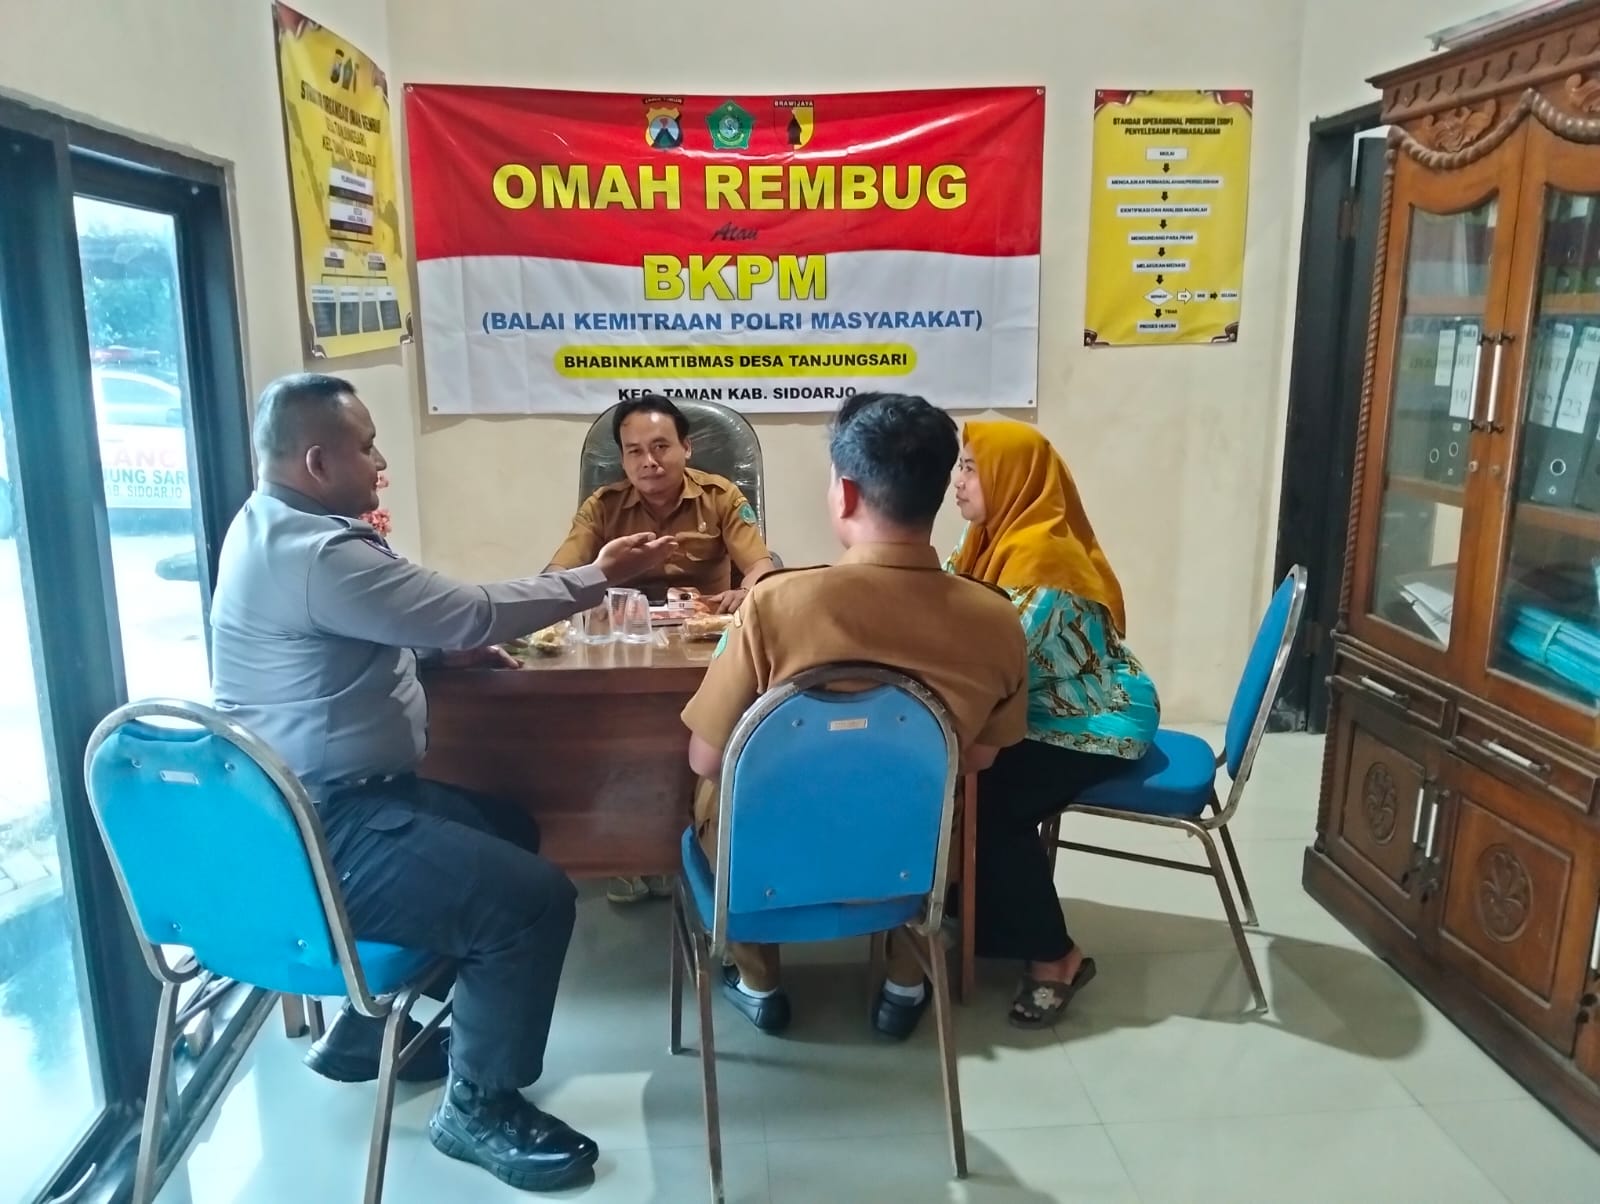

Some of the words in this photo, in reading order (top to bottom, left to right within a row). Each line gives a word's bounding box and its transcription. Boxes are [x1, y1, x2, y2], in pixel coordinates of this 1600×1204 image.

[1113, 118, 1140, 126] STANDAR
[1125, 127, 1170, 135] PENYELESAIAN
[492, 164, 680, 210] OMAH
[704, 164, 968, 210] REMBUG
[709, 221, 759, 241] Atau
[642, 254, 827, 301] BKPM
[482, 311, 564, 334] (BALAI
[574, 312, 721, 330] KEMITRAAN
[731, 312, 802, 330] POLRI
[811, 309, 983, 332] MASYARAKAT)
[564, 354, 735, 368] BHABINKAMTIBMAS
[739, 354, 784, 368] DESA
[788, 352, 907, 367] TANJUNGSARI
[663, 388, 722, 400] TAMAN
[728, 387, 768, 400] KAB.
[773, 386, 857, 399] SIDOARJO
[127, 484, 183, 498] SIDOARJO
